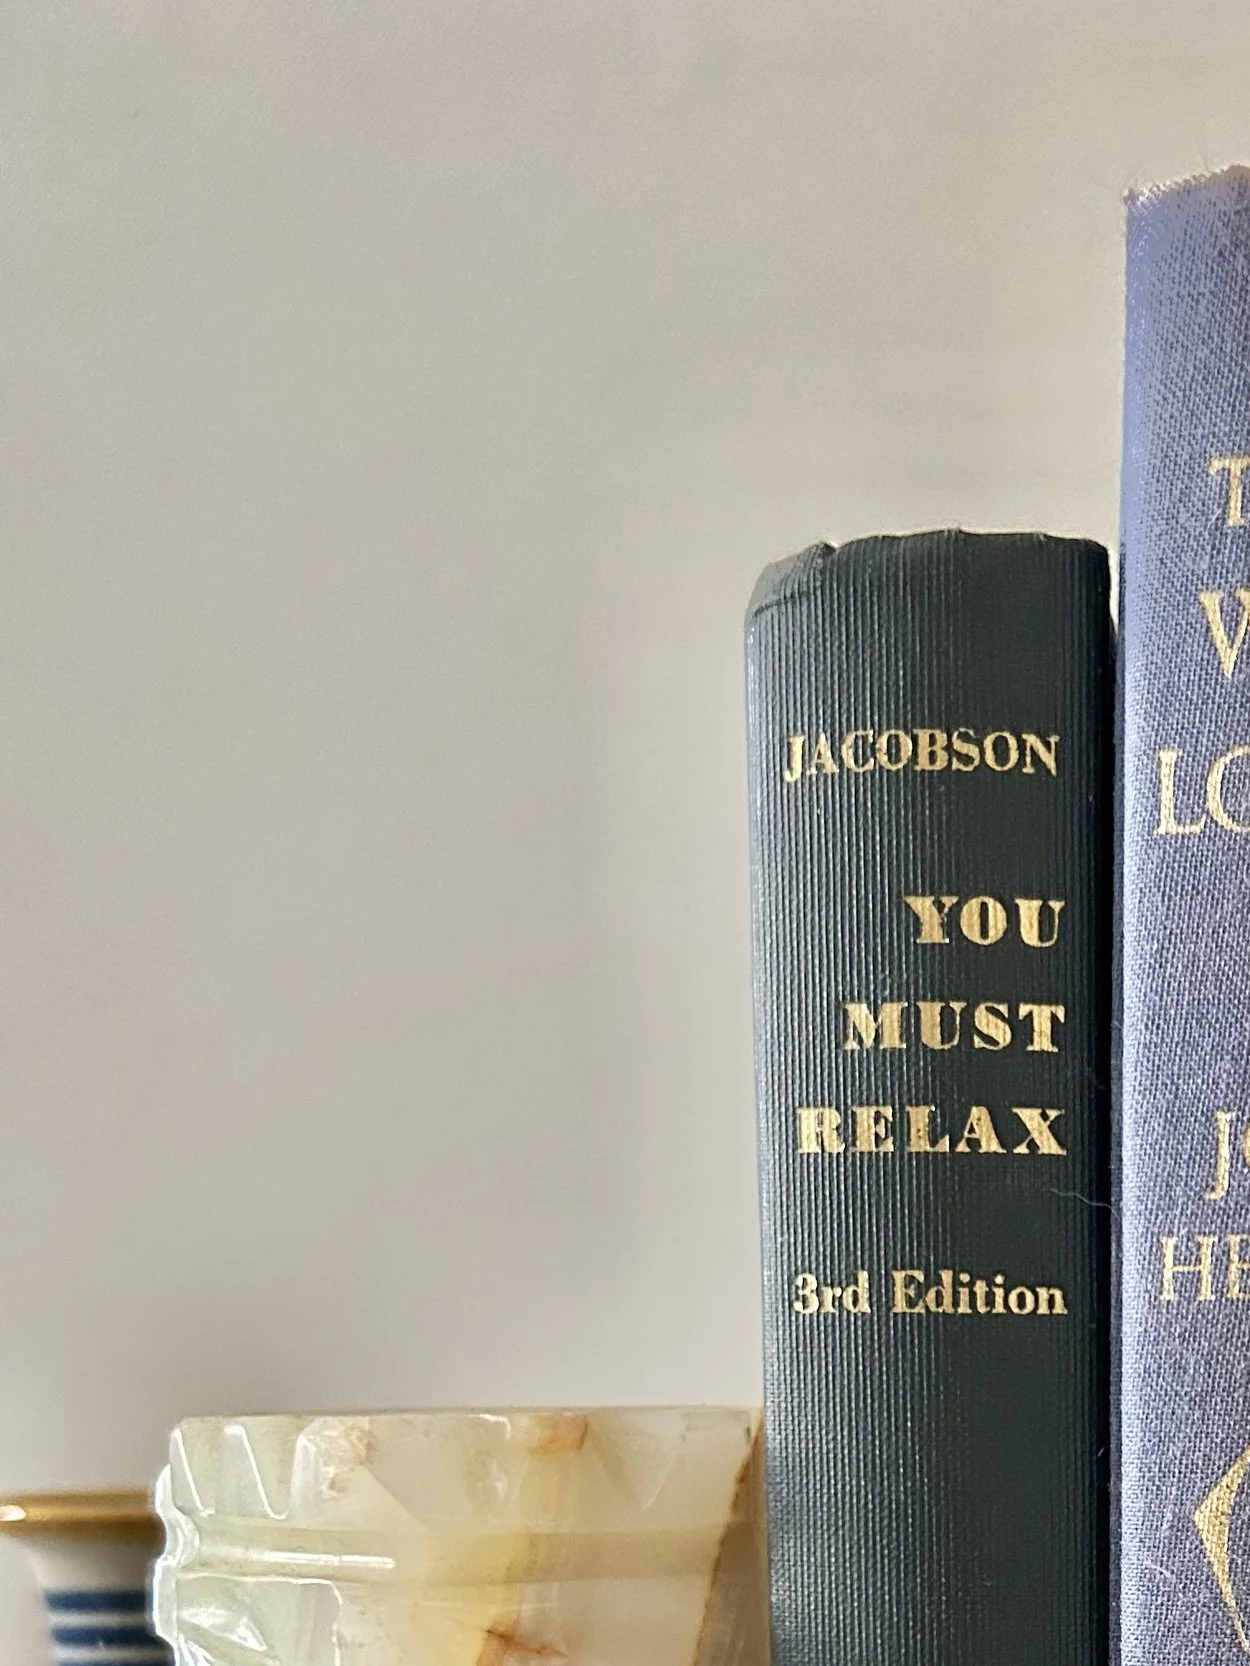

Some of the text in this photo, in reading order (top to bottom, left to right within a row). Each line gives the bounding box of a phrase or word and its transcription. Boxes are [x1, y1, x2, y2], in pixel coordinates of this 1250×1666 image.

[783, 729, 1060, 783] JACOBSON
[904, 895, 1065, 948] YOU
[843, 1001, 1065, 1052] MUST
[796, 1105, 1067, 1156] RELAX
[793, 1269, 1068, 1317] 3rd Edition
